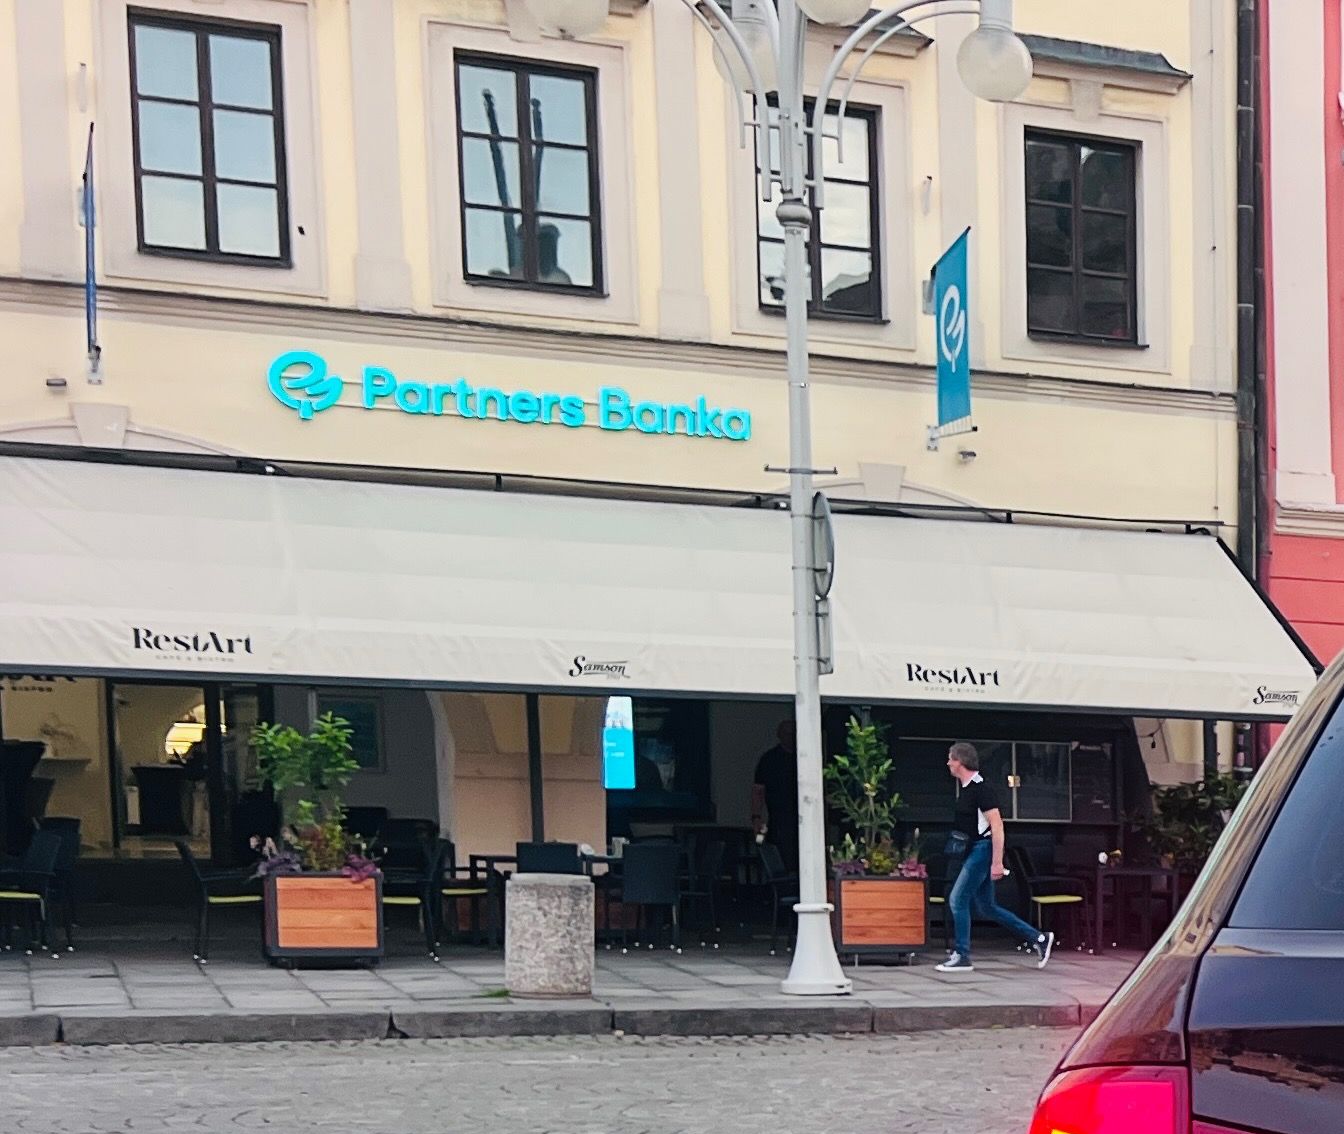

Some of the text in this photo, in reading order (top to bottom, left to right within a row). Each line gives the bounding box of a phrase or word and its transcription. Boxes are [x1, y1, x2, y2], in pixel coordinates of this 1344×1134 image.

[362, 366, 752, 442] Partners Banka
[132, 627, 254, 655] RestArt
[568, 655, 631, 679] Samson
[906, 663, 1000, 687] RestArt
